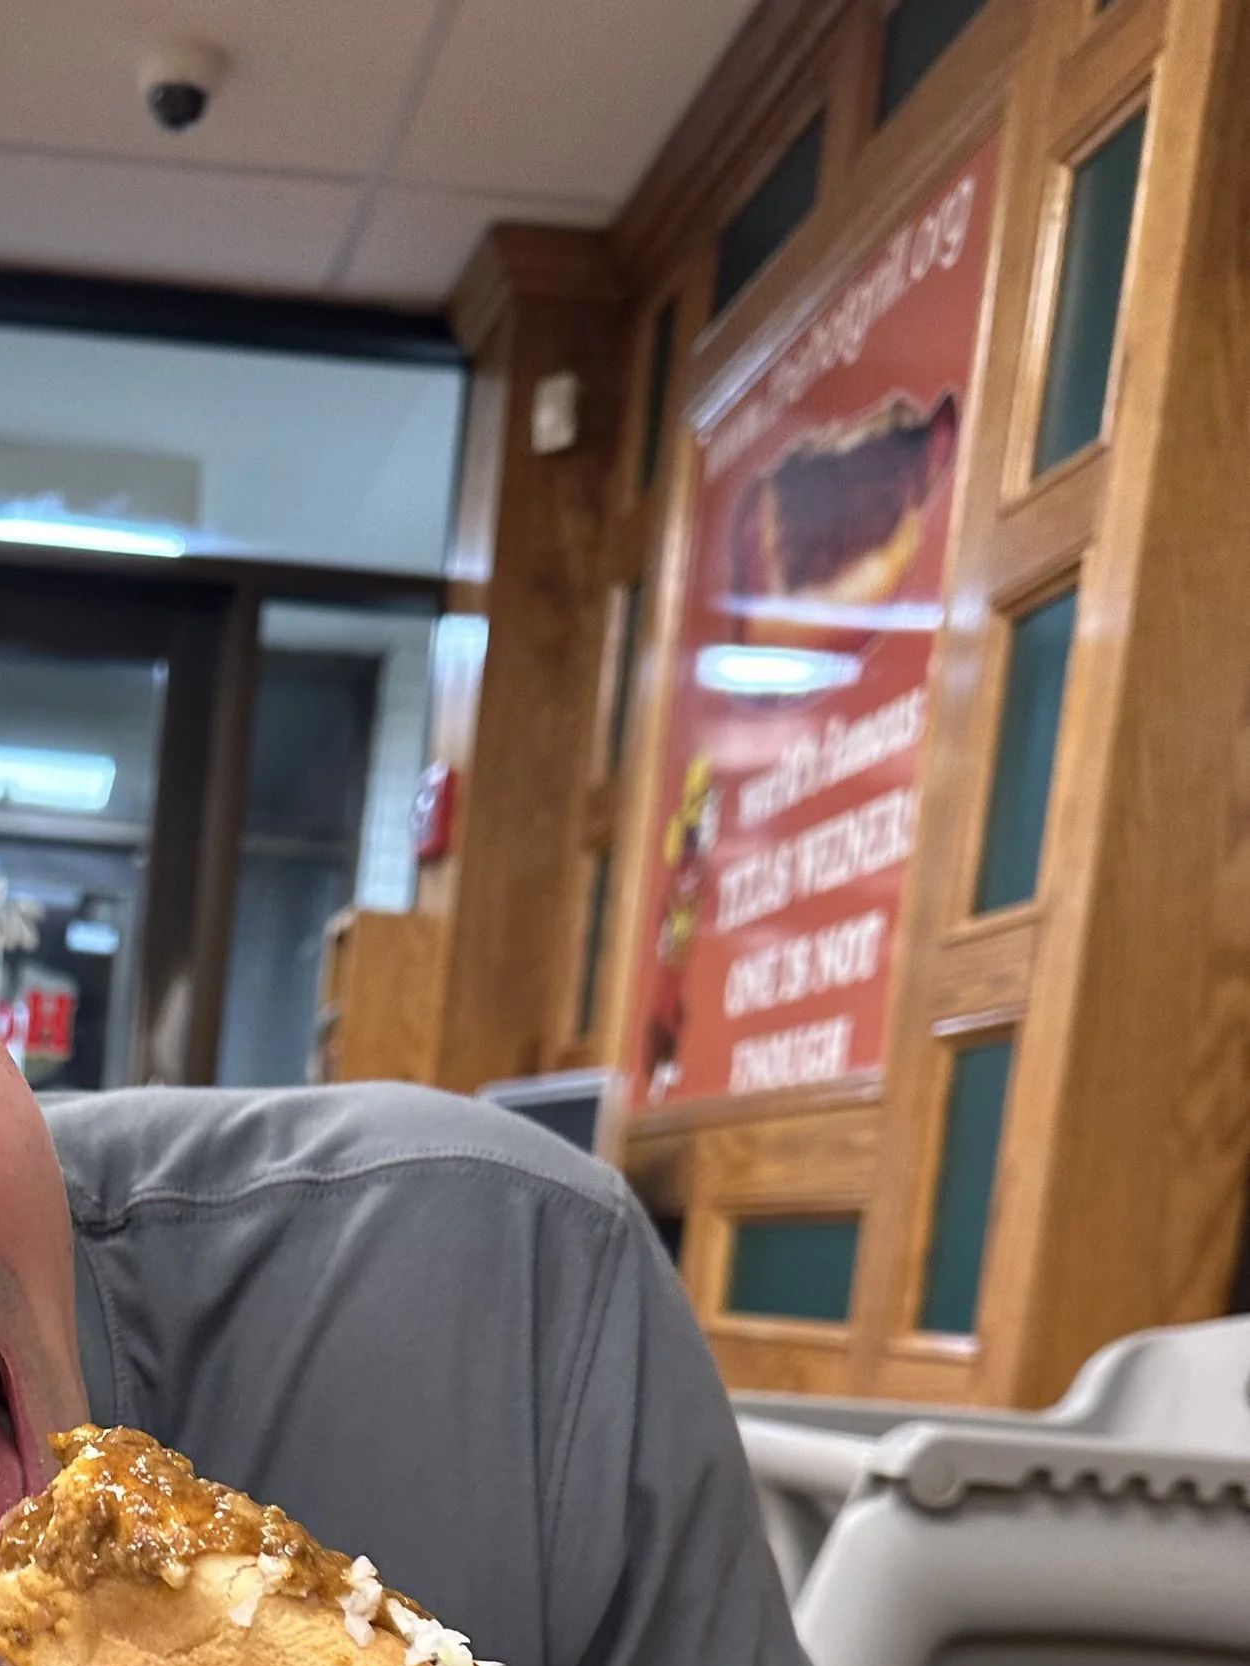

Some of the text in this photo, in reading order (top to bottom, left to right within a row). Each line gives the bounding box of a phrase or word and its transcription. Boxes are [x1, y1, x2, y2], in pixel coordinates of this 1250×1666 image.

[724, 909, 887, 1018] ONE IS NOT
[729, 1014, 853, 1096] ENOUGH
